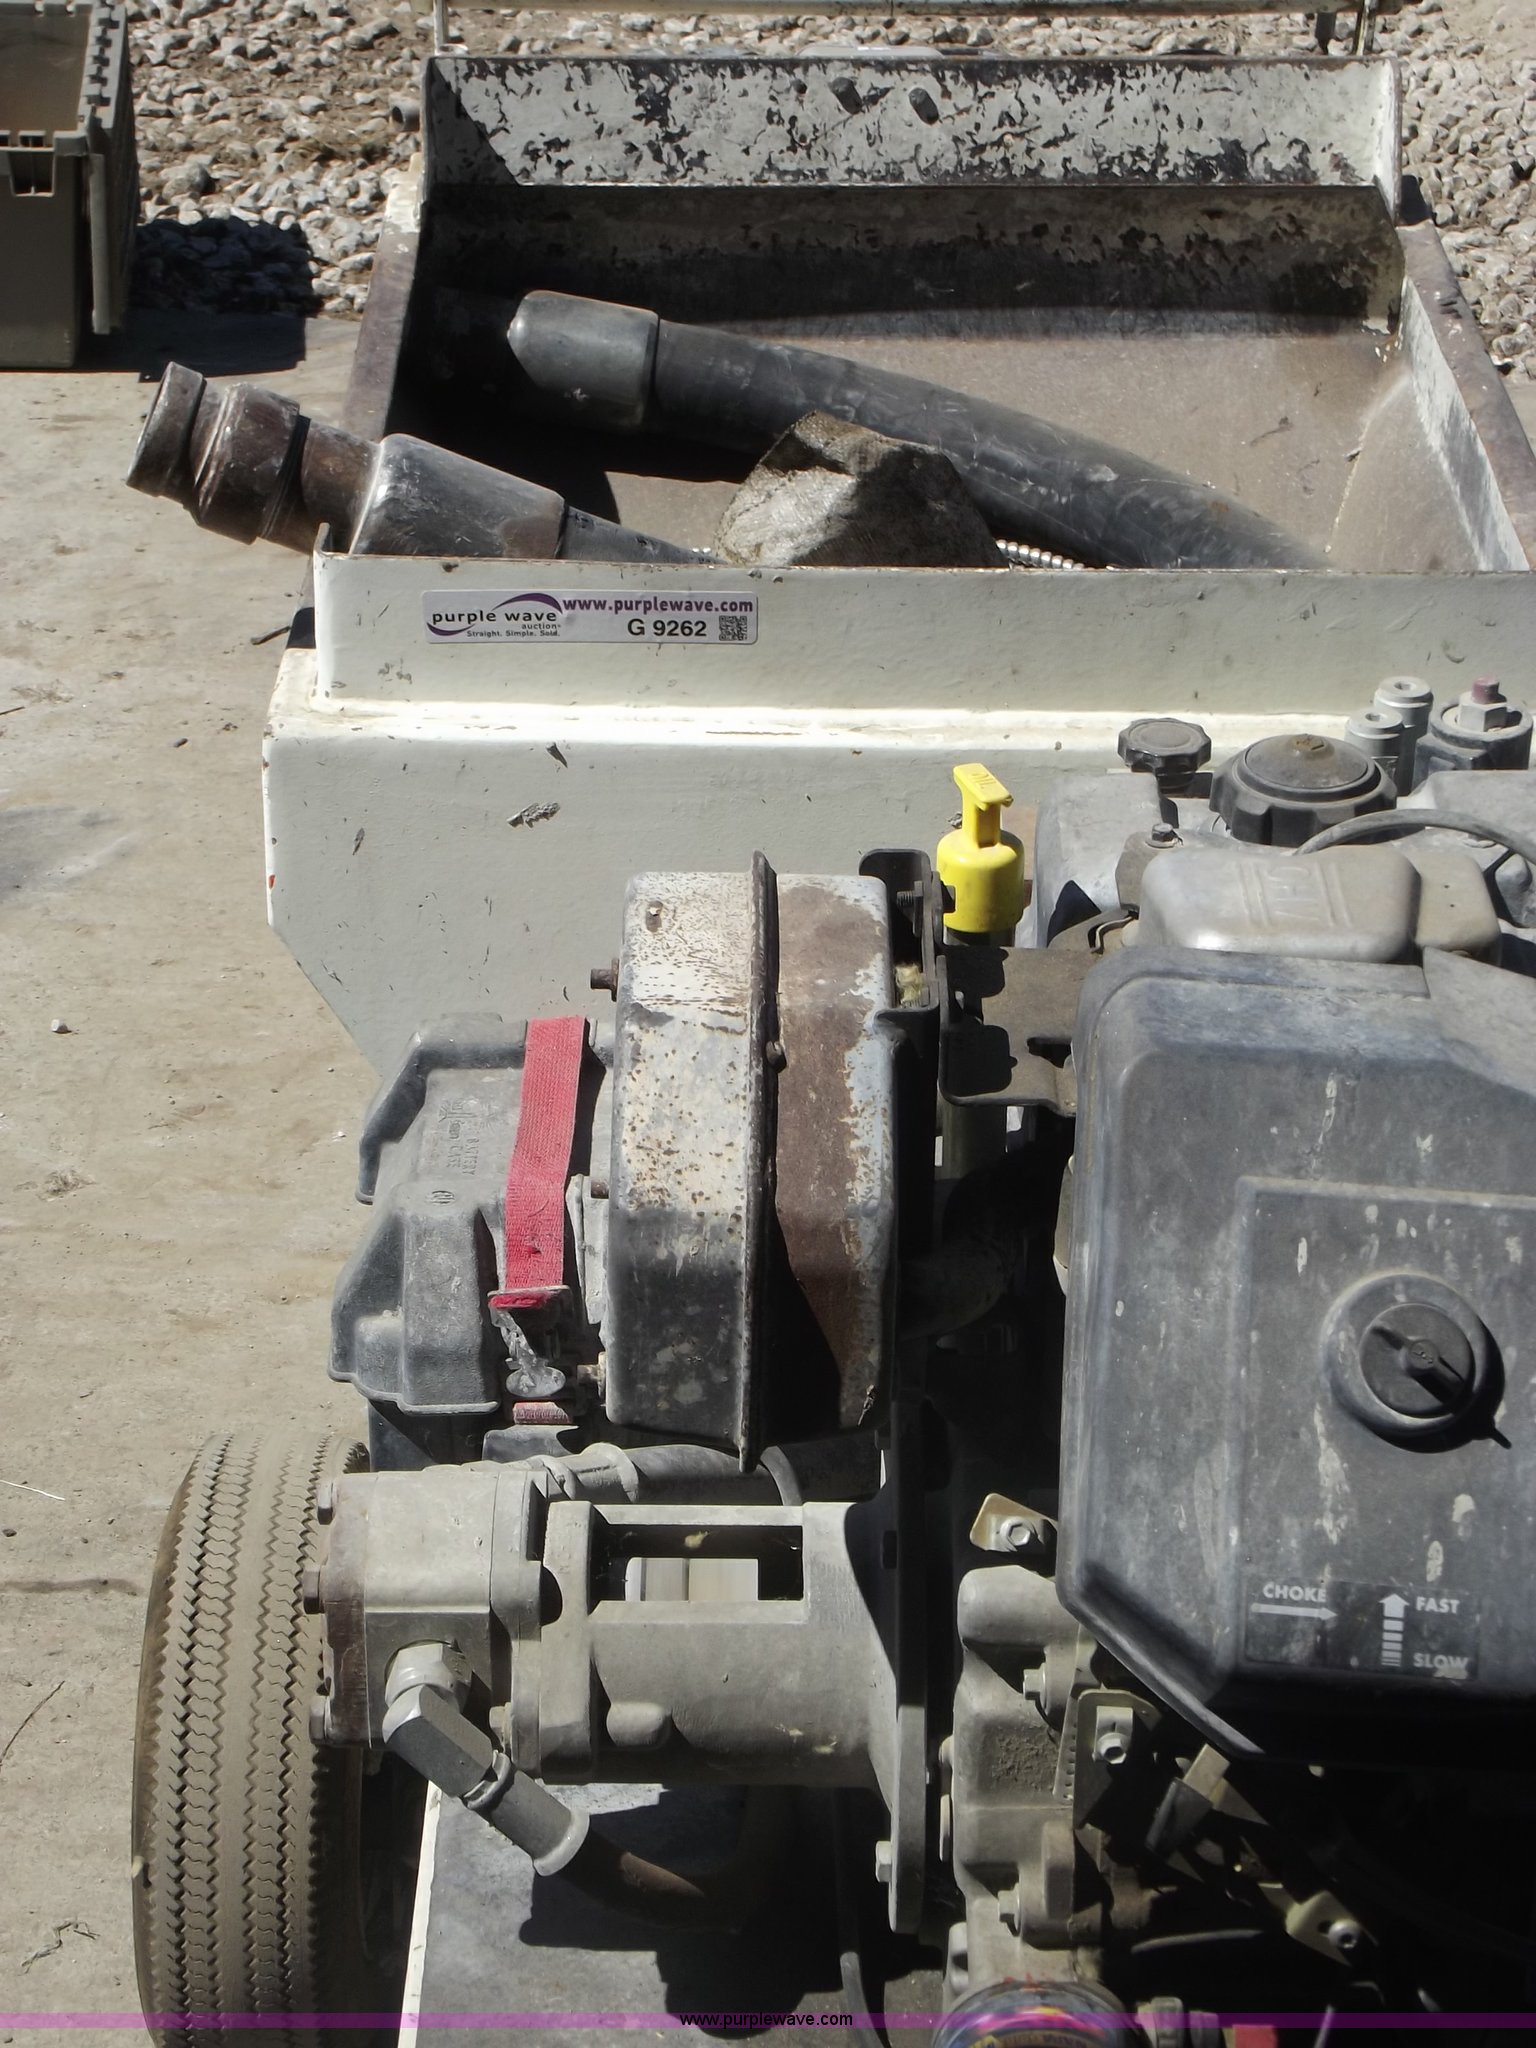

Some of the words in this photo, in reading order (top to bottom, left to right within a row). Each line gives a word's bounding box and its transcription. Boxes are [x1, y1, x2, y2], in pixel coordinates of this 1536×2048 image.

[563, 597, 754, 614] www.purplewave.com
[432, 610, 497, 625] purple
[505, 612, 557, 622] wave
[521, 622, 557, 630] auction
[466, 630, 502, 638] Straight.
[505, 630, 537, 638] Simple.
[628, 619, 645, 636] G
[653, 620, 707, 637] 9262
[1263, 1582, 1327, 1602] CHOKE
[1416, 1596, 1461, 1614] FAST
[1413, 1652, 1469, 1670] SLOW
